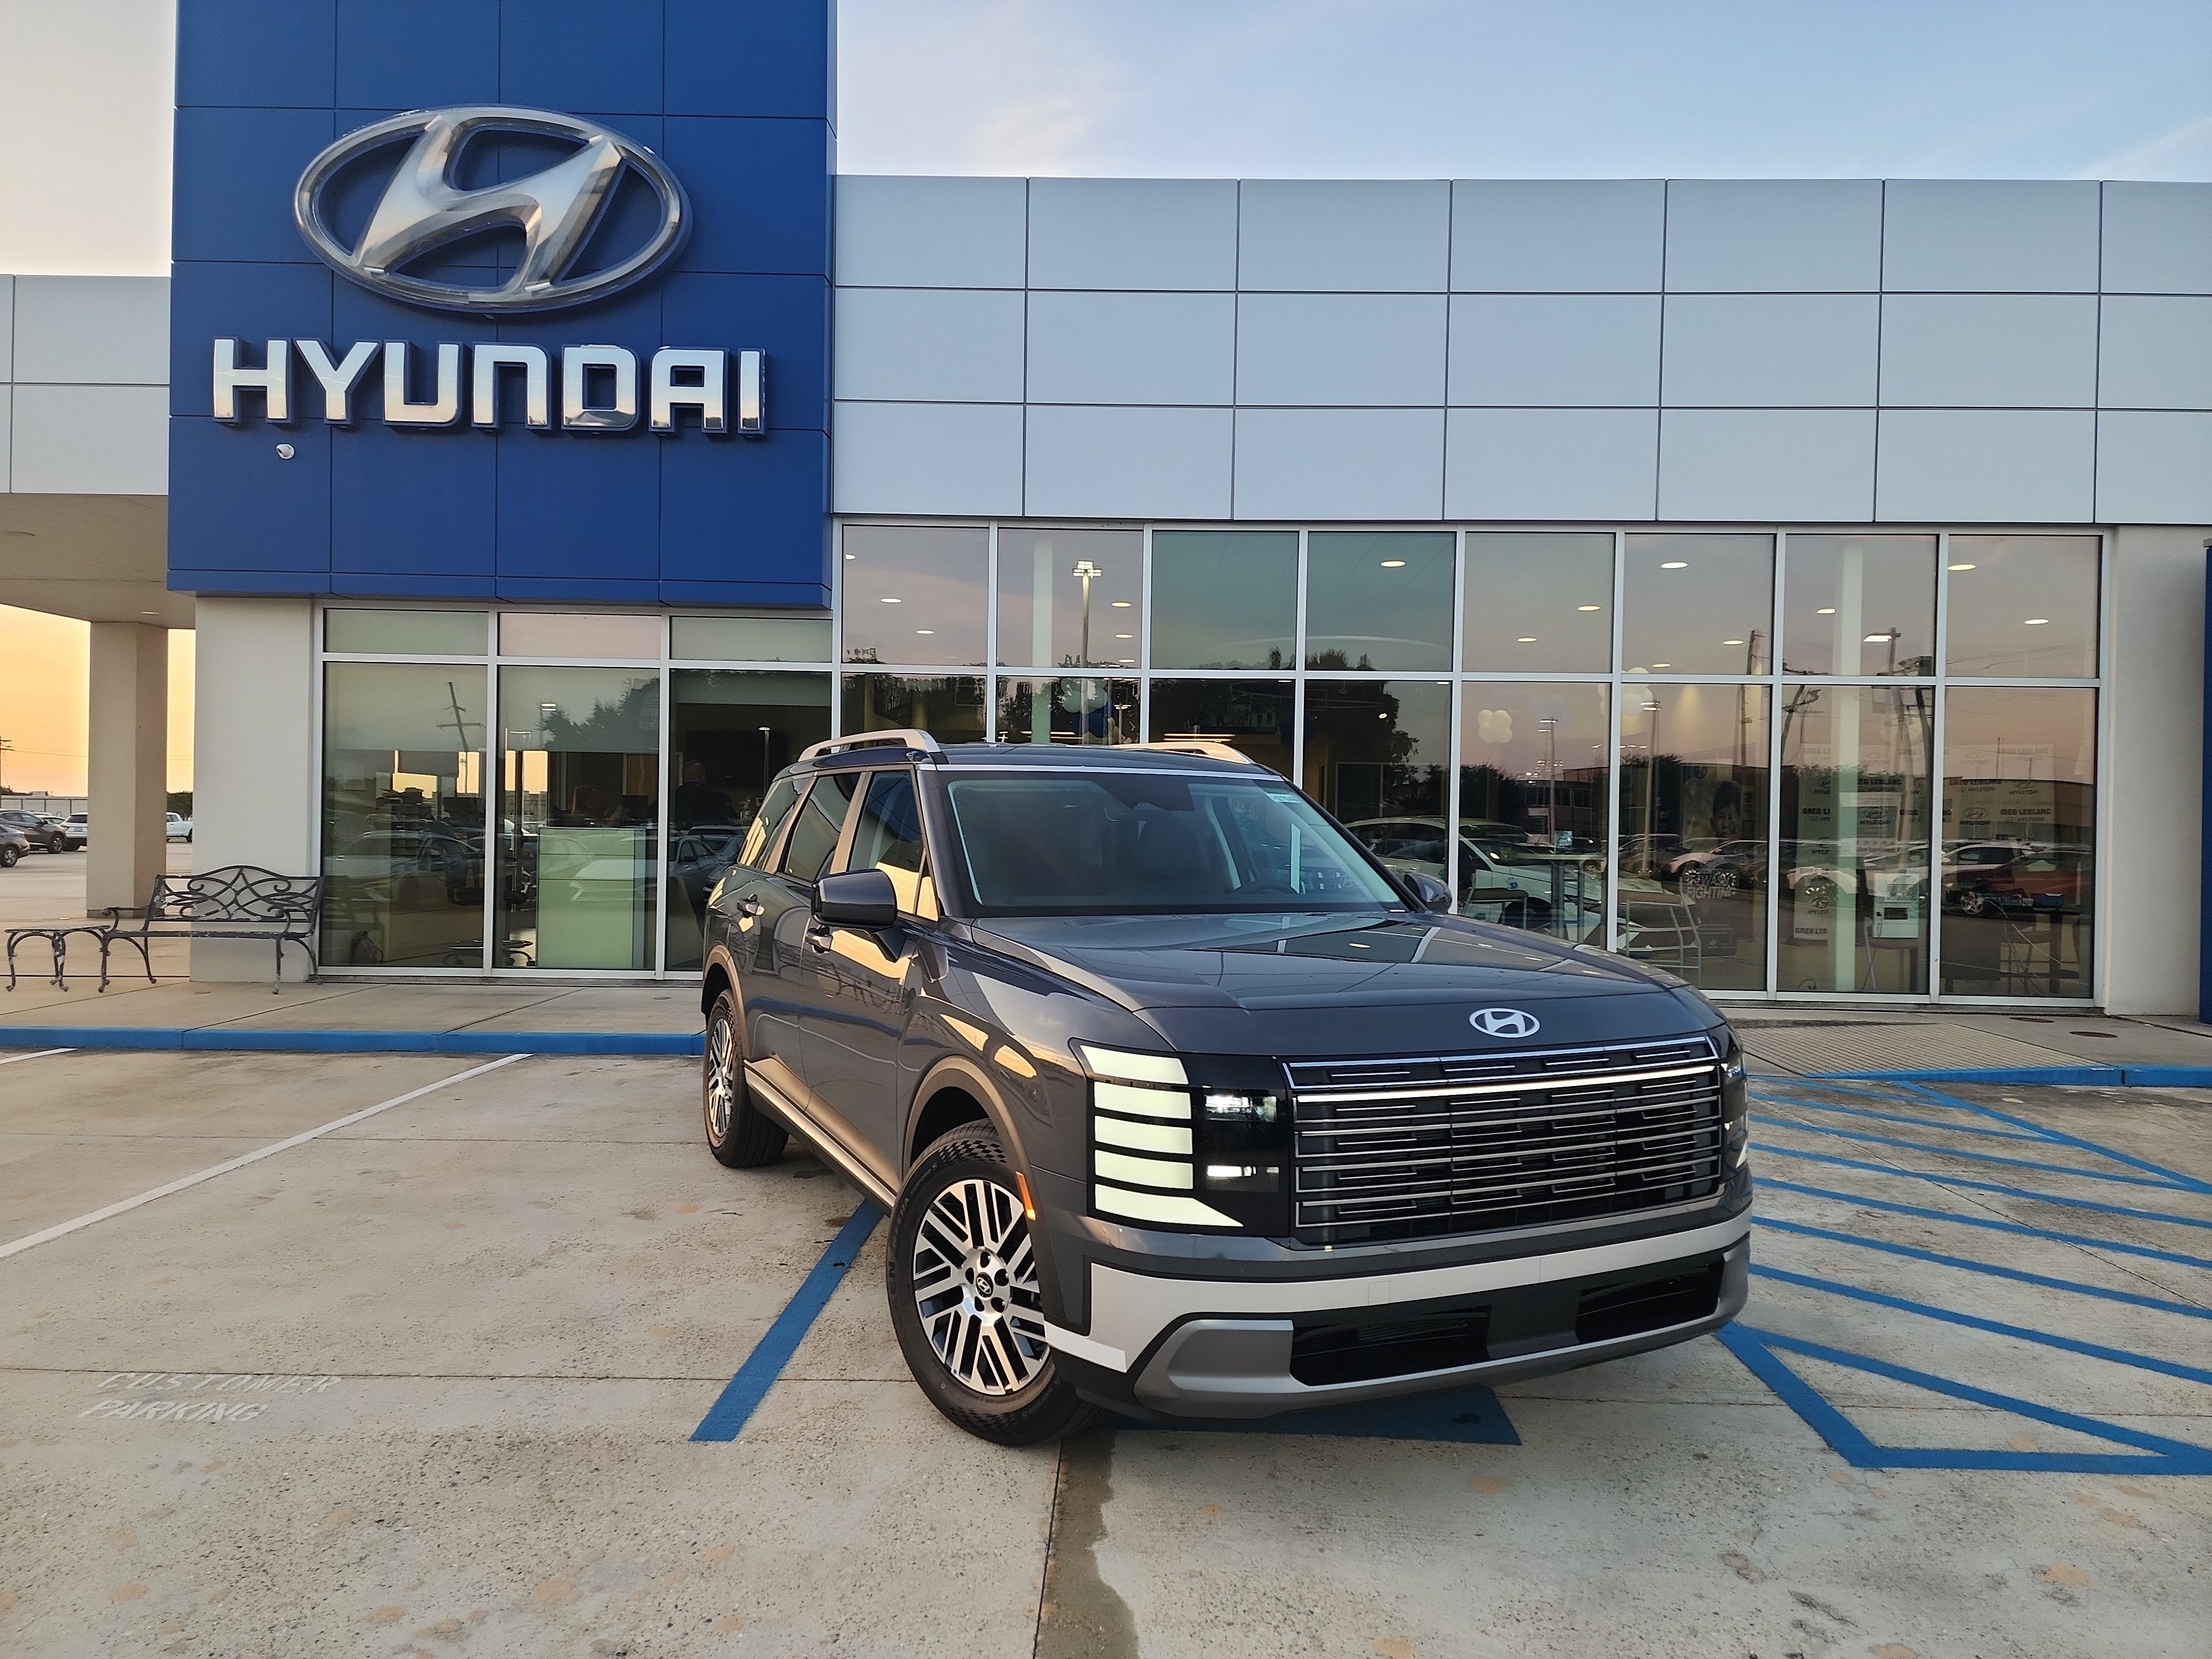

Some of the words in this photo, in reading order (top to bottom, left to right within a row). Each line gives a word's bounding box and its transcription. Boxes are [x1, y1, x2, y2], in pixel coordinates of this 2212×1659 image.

[213, 338, 763, 432] HYUNDAI
[96, 1372, 341, 1394] CUSTOMER
[77, 1400, 269, 1422] PARKING
